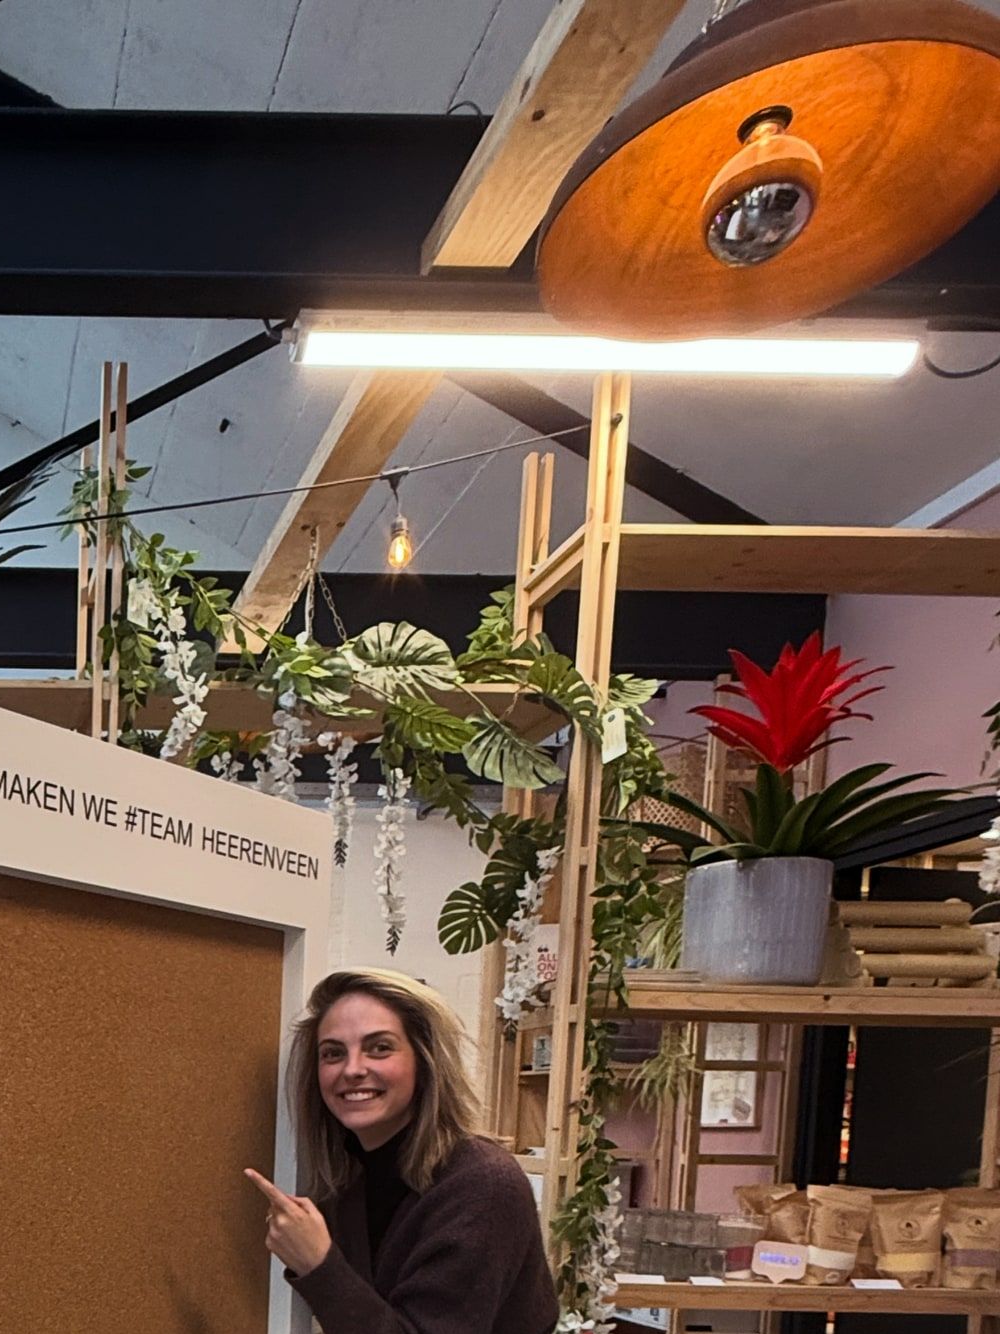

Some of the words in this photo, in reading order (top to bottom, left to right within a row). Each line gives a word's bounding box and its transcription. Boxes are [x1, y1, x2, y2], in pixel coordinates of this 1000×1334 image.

[82, 791, 118, 828] WE
[124, 804, 193, 848] #TEAM
[202, 826, 319, 880] HEERENVEEN
